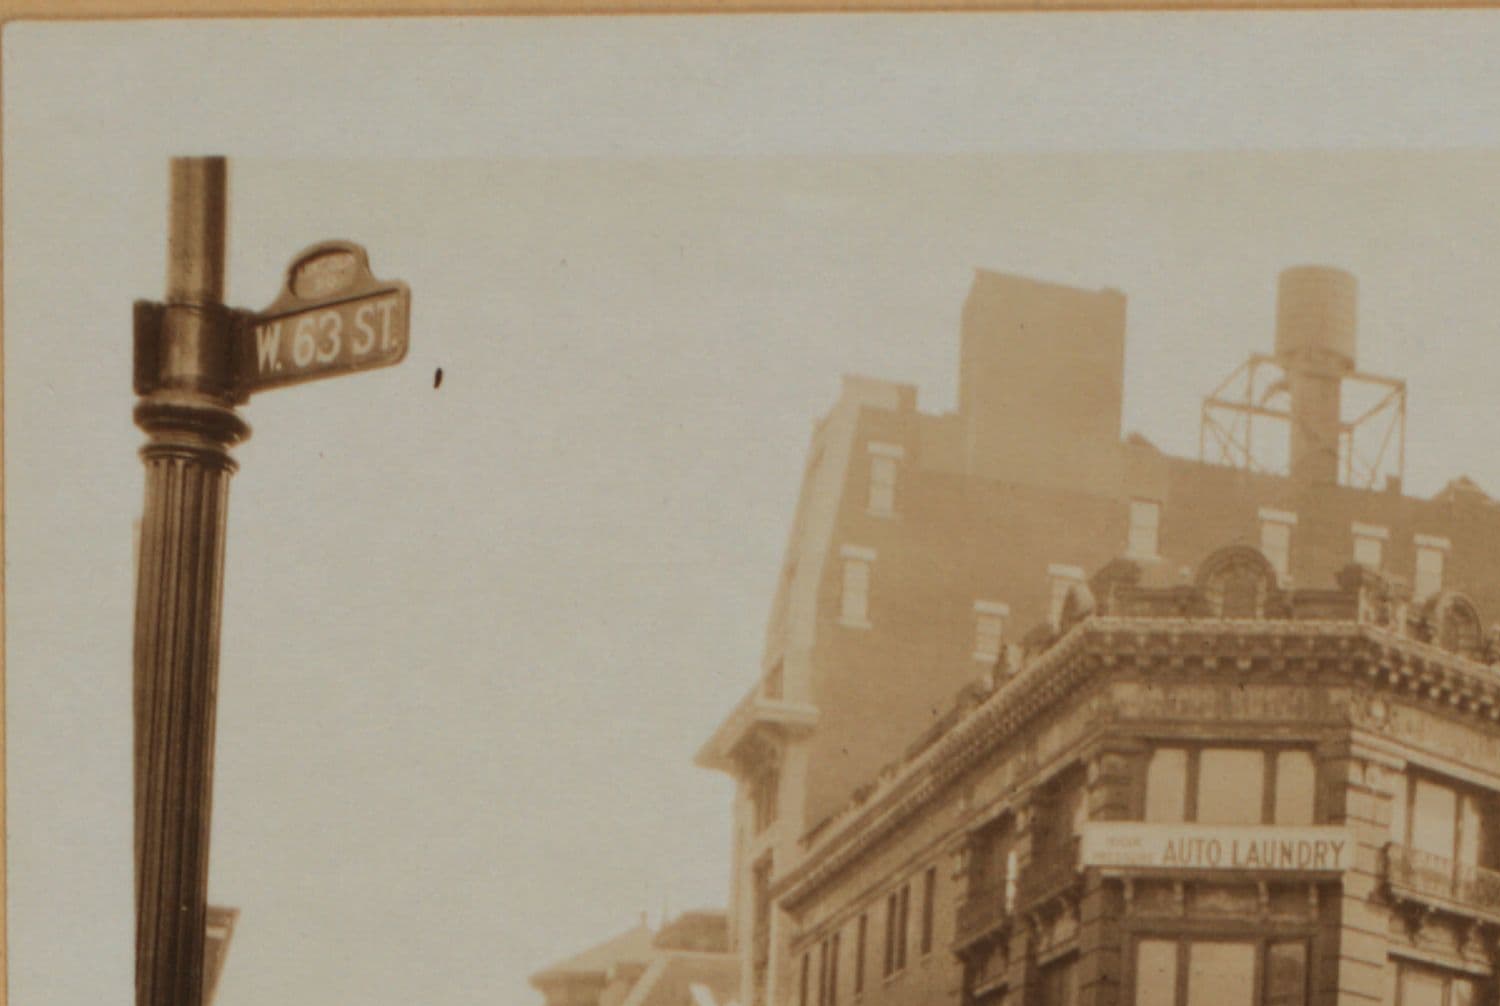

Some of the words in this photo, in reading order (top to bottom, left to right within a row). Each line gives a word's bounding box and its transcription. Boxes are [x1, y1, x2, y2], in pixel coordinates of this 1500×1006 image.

[256, 320, 283, 375] W.
[294, 310, 342, 368] 63
[352, 298, 399, 356] ST.
[1162, 838, 1224, 866] AUTO
[1231, 839, 1346, 869] LAUNDRY
